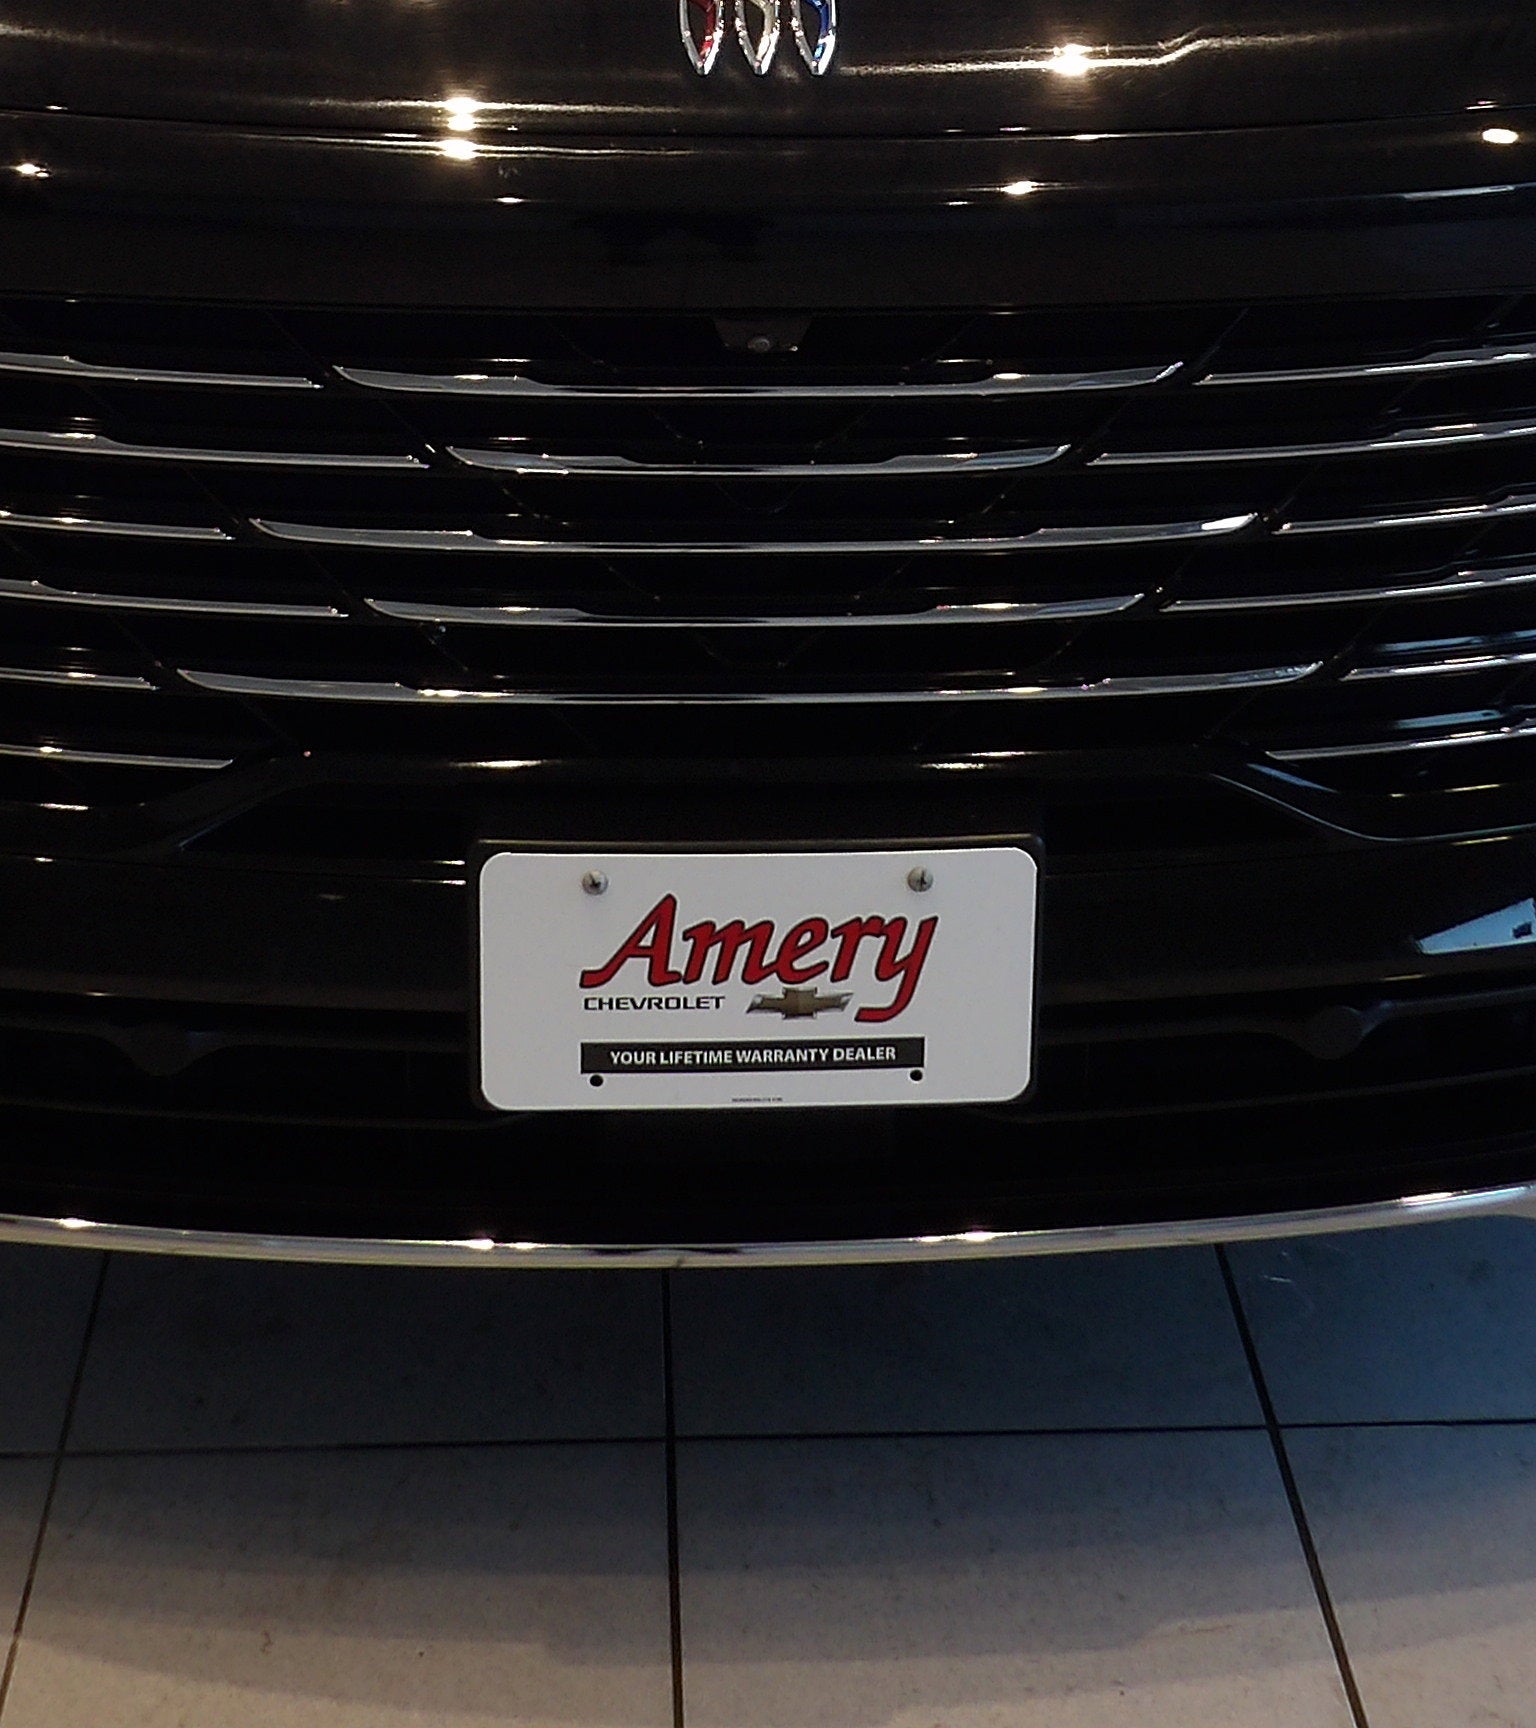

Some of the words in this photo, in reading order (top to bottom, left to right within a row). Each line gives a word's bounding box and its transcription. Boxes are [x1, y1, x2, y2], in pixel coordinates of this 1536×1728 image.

[579, 892, 939, 1023] Amery
[584, 995, 726, 1011] CHEVROLET
[610, 1050, 657, 1065] YOUR
[659, 1049, 733, 1065] LIFETIME
[735, 1047, 830, 1064] WARRANTY
[832, 1045, 897, 1062] DEALER
